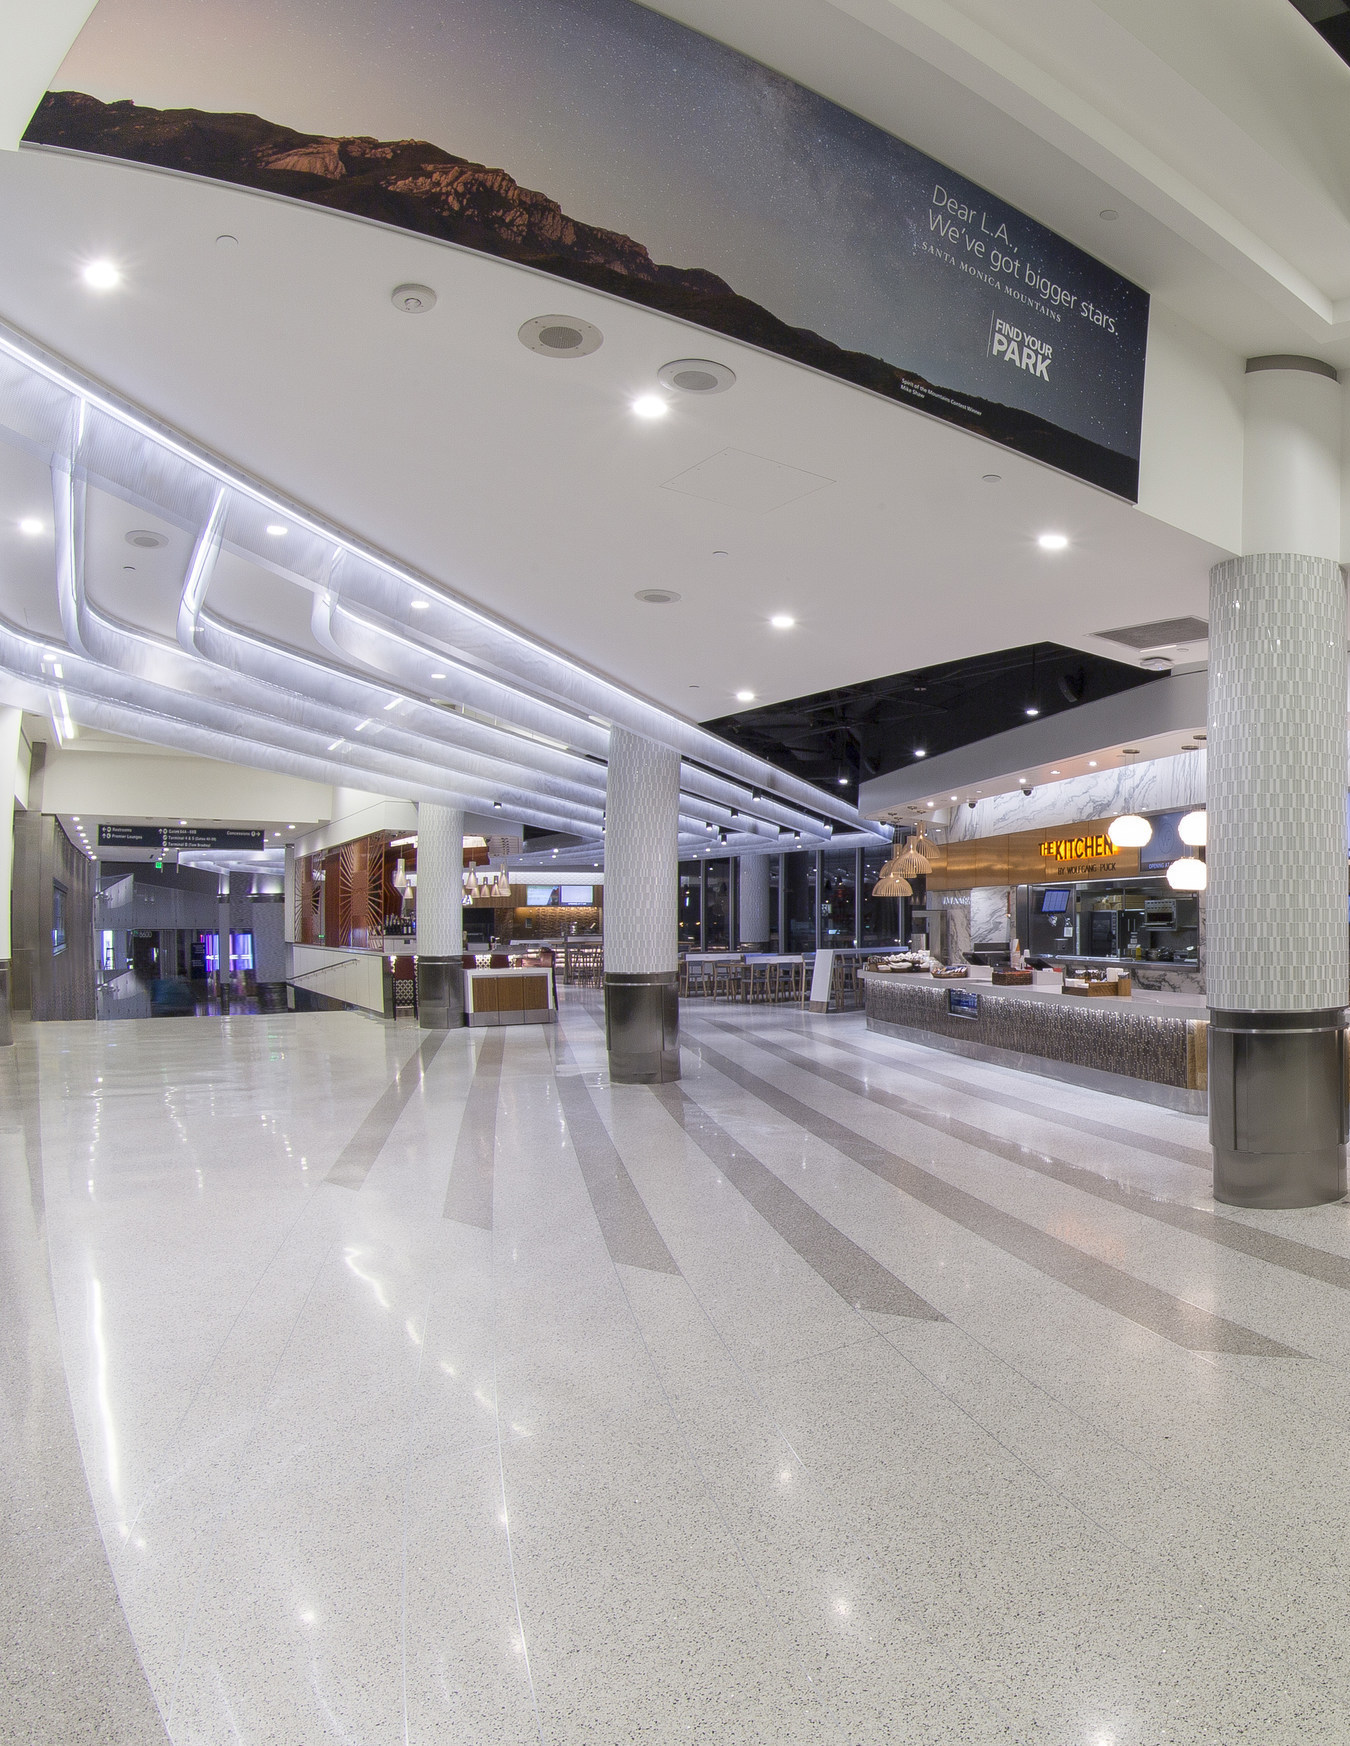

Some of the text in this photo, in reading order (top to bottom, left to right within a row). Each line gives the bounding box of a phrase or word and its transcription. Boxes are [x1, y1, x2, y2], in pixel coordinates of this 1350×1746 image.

[932, 184, 1018, 253] Dear L.A.,
[921, 241, 1061, 323] SANTA MONICA MOUNTAINS
[929, 208, 1119, 336] We've got bigger stars.
[992, 331, 1052, 382] PARK
[995, 318, 1053, 359] FIND YOUR
[1038, 833, 1115, 860] THE KITCHEN
[1057, 862, 1117, 876] BY WOLFGANG PUCK
